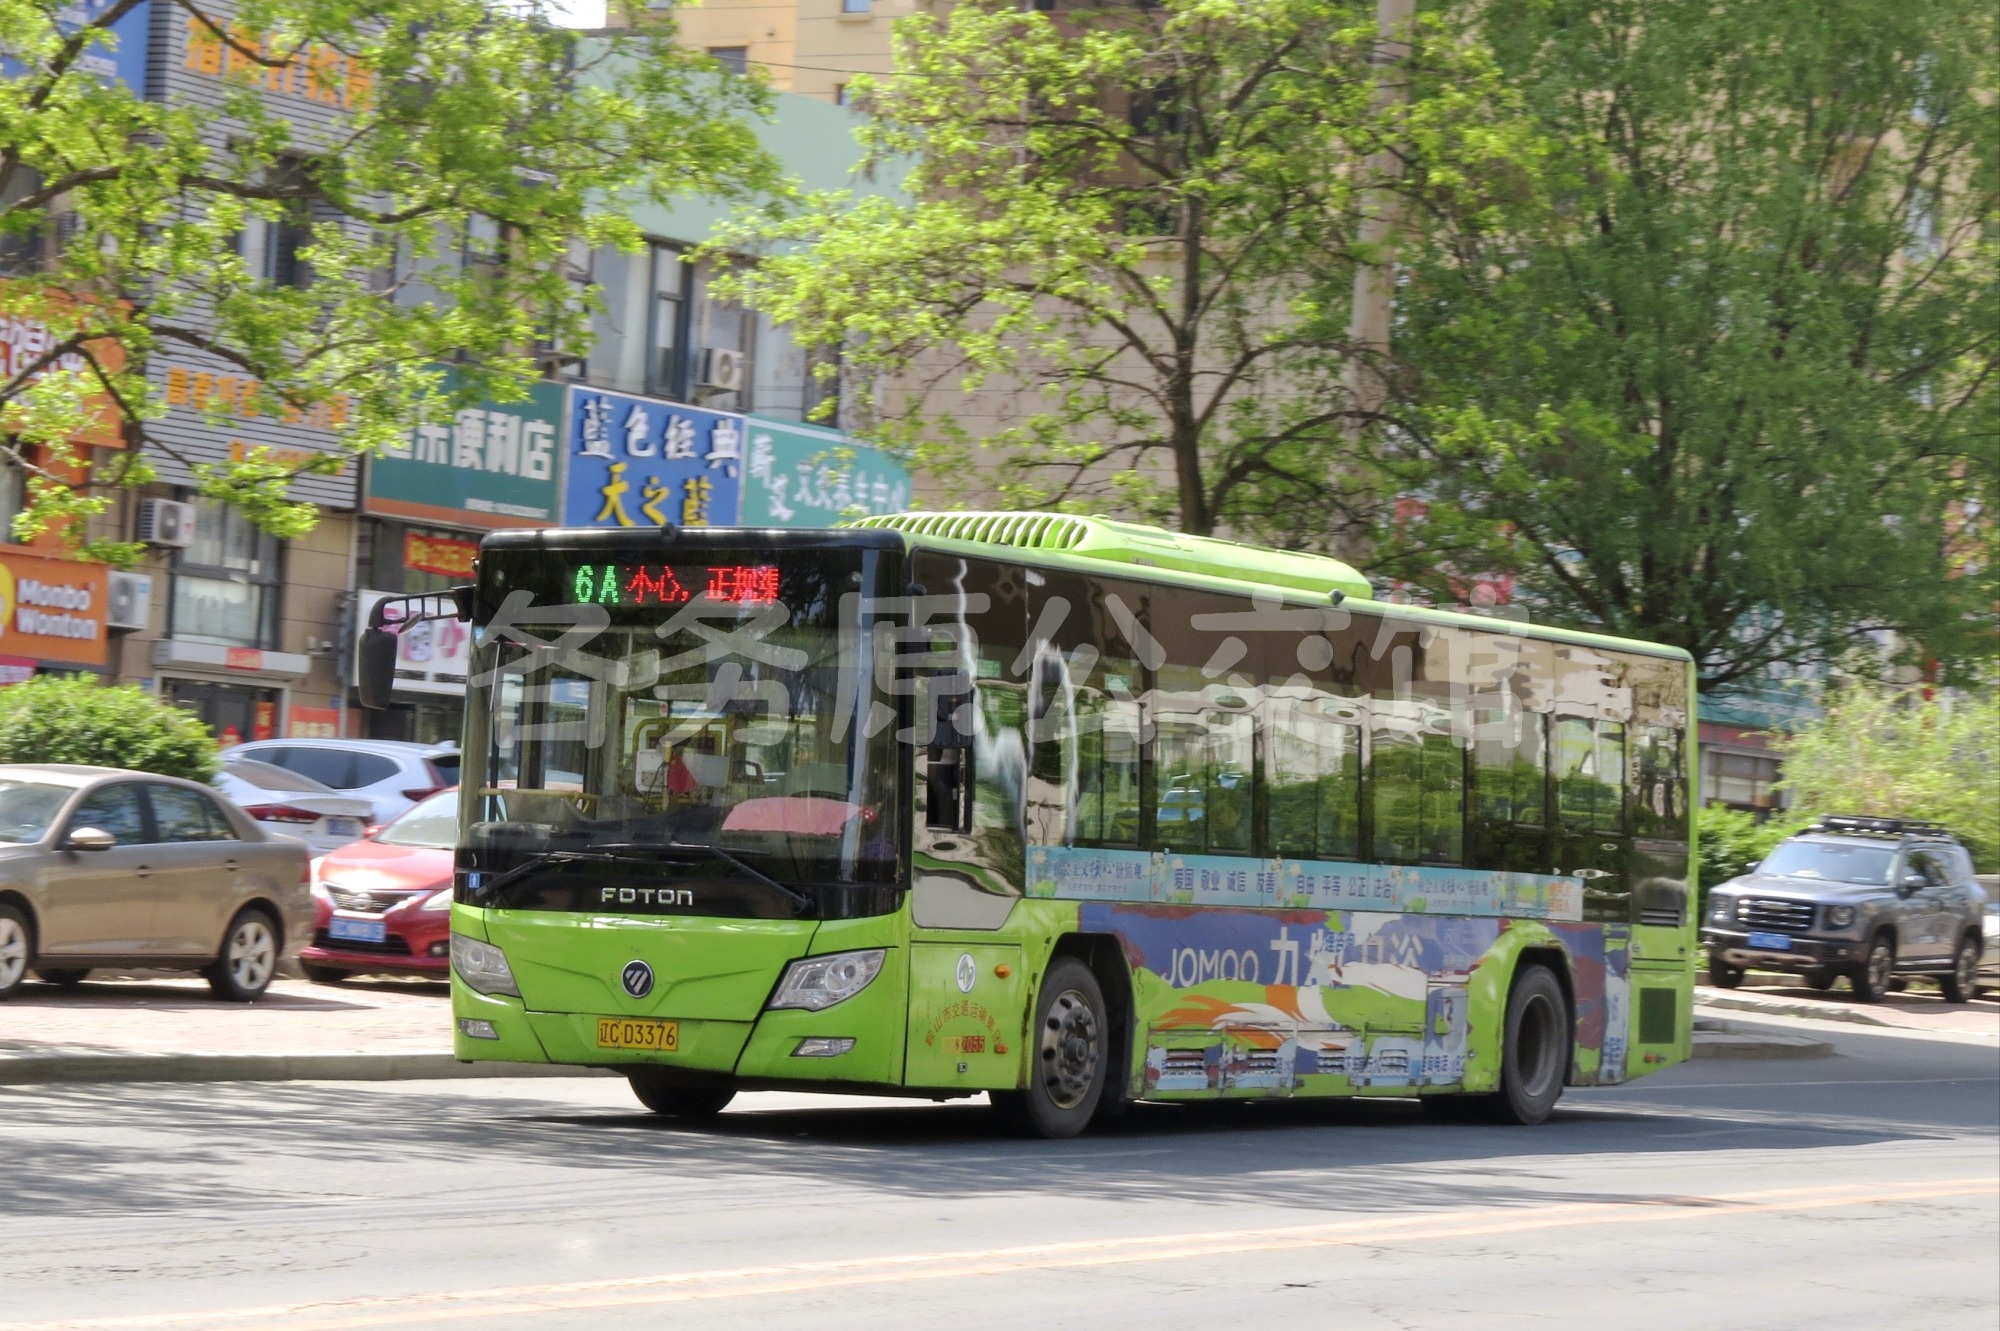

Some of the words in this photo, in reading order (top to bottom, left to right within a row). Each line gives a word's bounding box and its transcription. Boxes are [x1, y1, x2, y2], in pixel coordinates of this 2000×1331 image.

[17, 578, 91, 611] Monbo
[575, 565, 620, 603] 6A
[16, 607, 98, 640] Wonton
[601, 886, 694, 906] FOTON
[1174, 868, 1195, 891] 爱国
[1200, 869, 1220, 892] 敬业
[1226, 870, 1247, 893] 诚信
[1296, 873, 1316, 895] 自由
[1322, 874, 1342, 897] 平等
[1348, 876, 1367, 898] 公正
[1161, 948, 1260, 988] JOMOO
